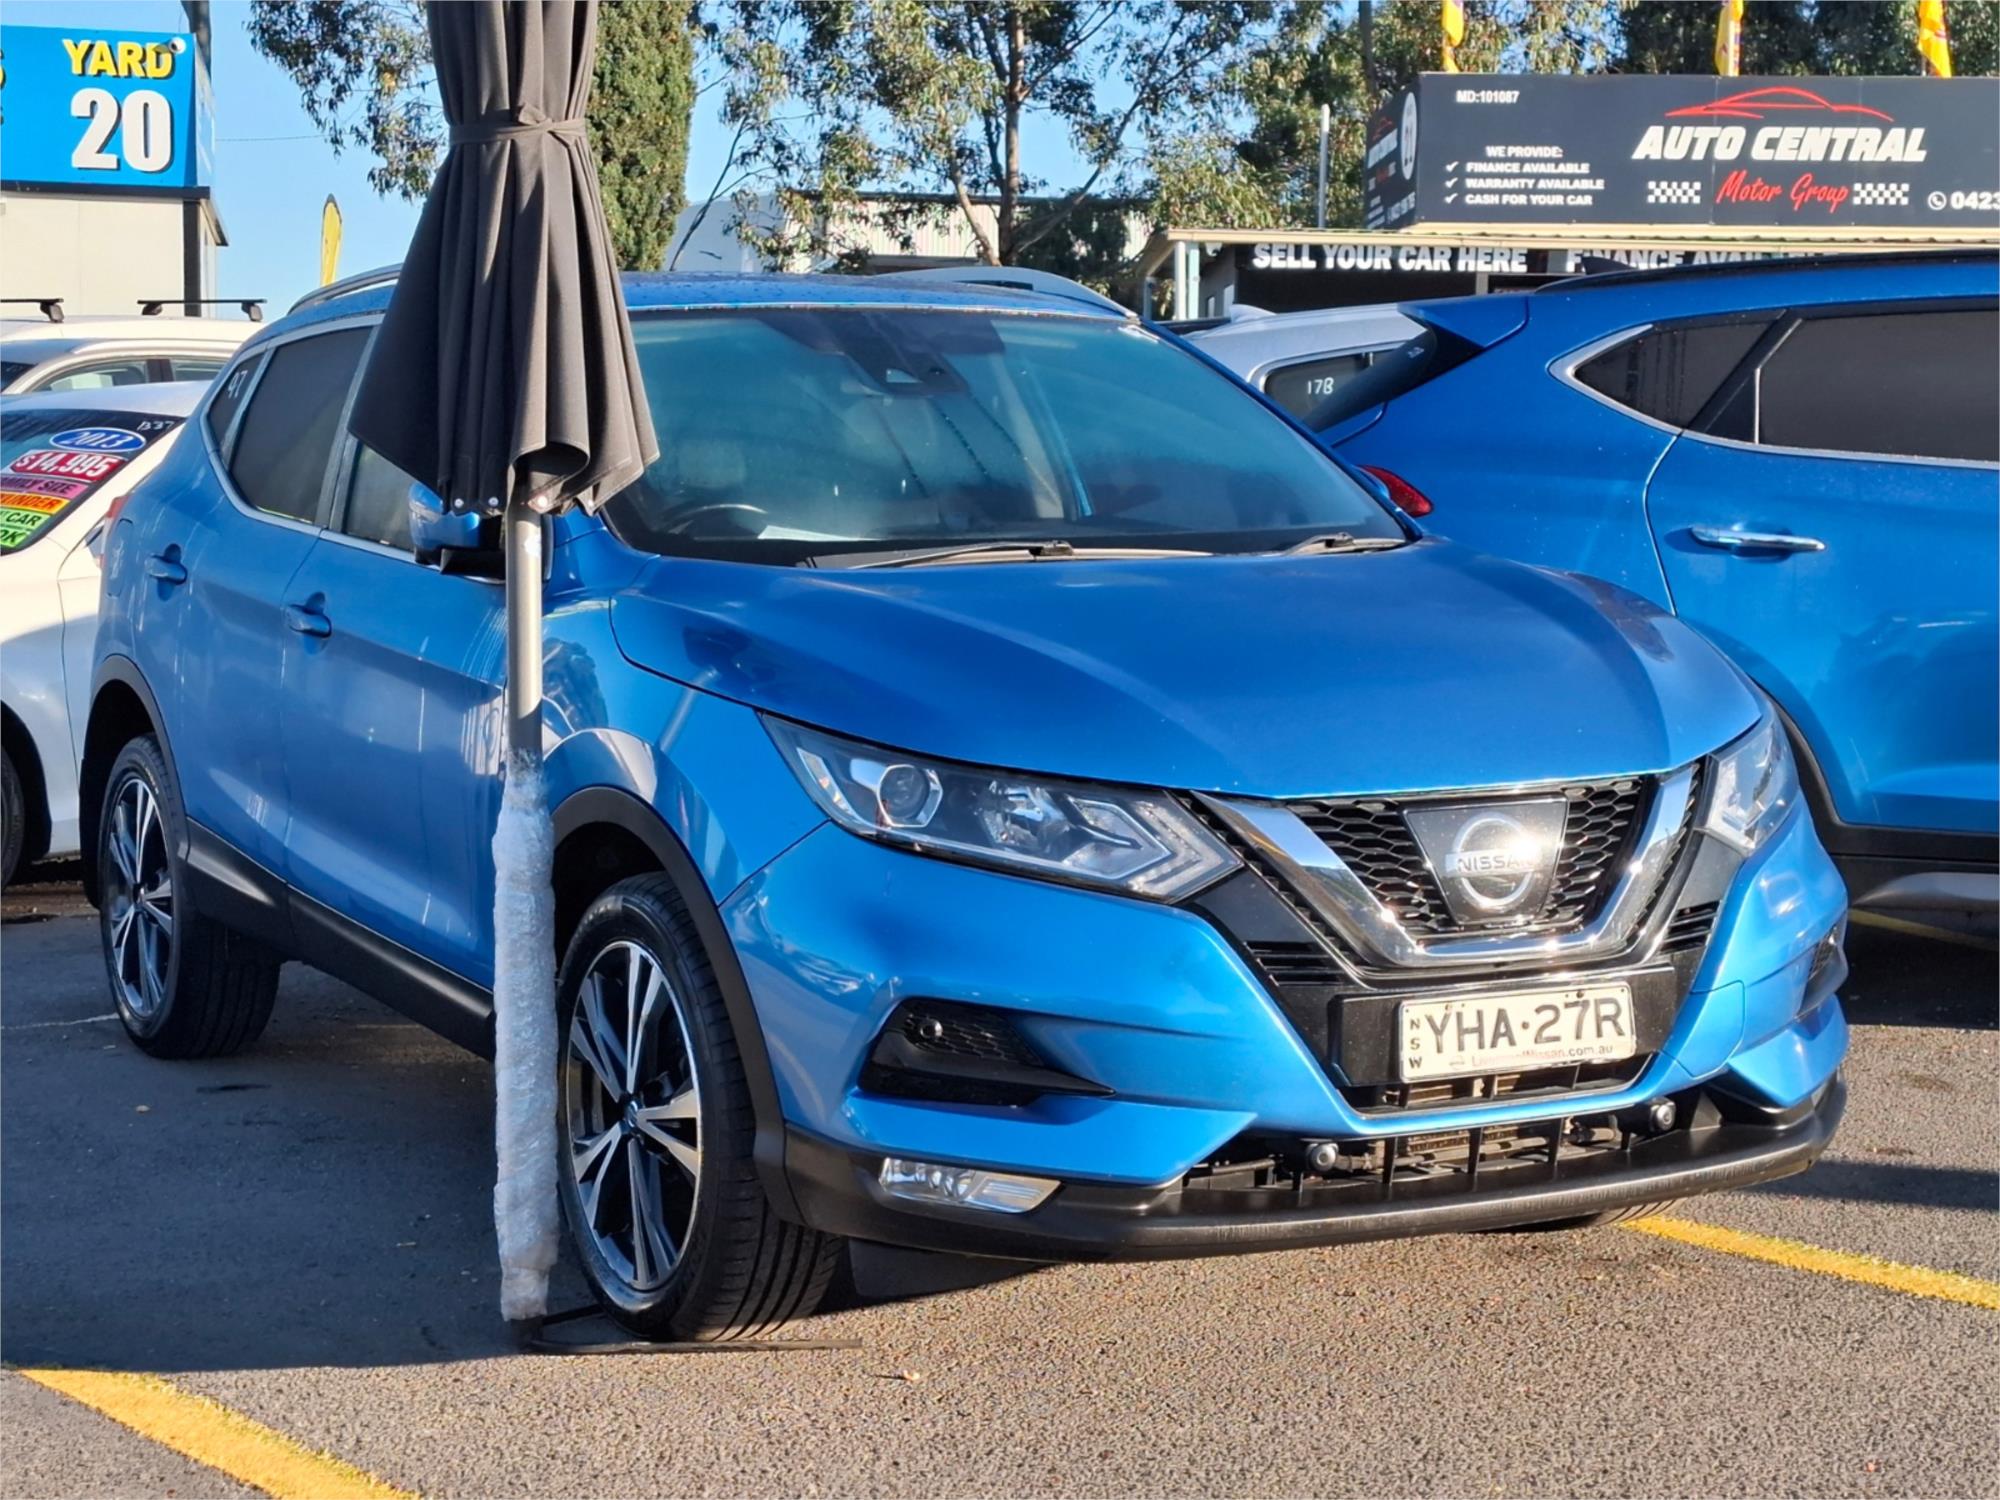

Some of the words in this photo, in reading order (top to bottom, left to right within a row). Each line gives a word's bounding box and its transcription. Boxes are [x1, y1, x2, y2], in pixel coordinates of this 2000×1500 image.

[62, 39, 173, 79] YARD
[70, 88, 172, 172] 20
[1486, 146, 1506, 157] WE
[1507, 147, 1563, 158] PROVIDE:
[1631, 126, 1746, 160] AUTO
[1750, 128, 1927, 162] CENTRAL
[1466, 163, 1521, 173] FINANCE
[1522, 163, 1590, 174] AVAILABLE
[1465, 178, 1535, 189] WARRANTY
[1537, 179, 1605, 190] AVAILABLE
[1716, 170, 1783, 204] Motor
[1790, 173, 1849, 213] Group
[1465, 194, 1500, 205] CASH
[1502, 195, 1528, 205] FOR
[1529, 195, 1565, 206] YOUR
[1567, 195, 1593, 206] CAR
[1252, 243, 1317, 269] SELL
[1322, 244, 1393, 270] YOUR
[1398, 246, 1451, 271] CAR
[1456, 248, 1528, 272] HERE
[63, 431, 134, 448] 2013
[15, 452, 118, 477] $14,995
[37, 480, 77, 494] SIZE
[6, 512, 42, 526] CAR
[1457, 854, 1534, 872] NISSA
